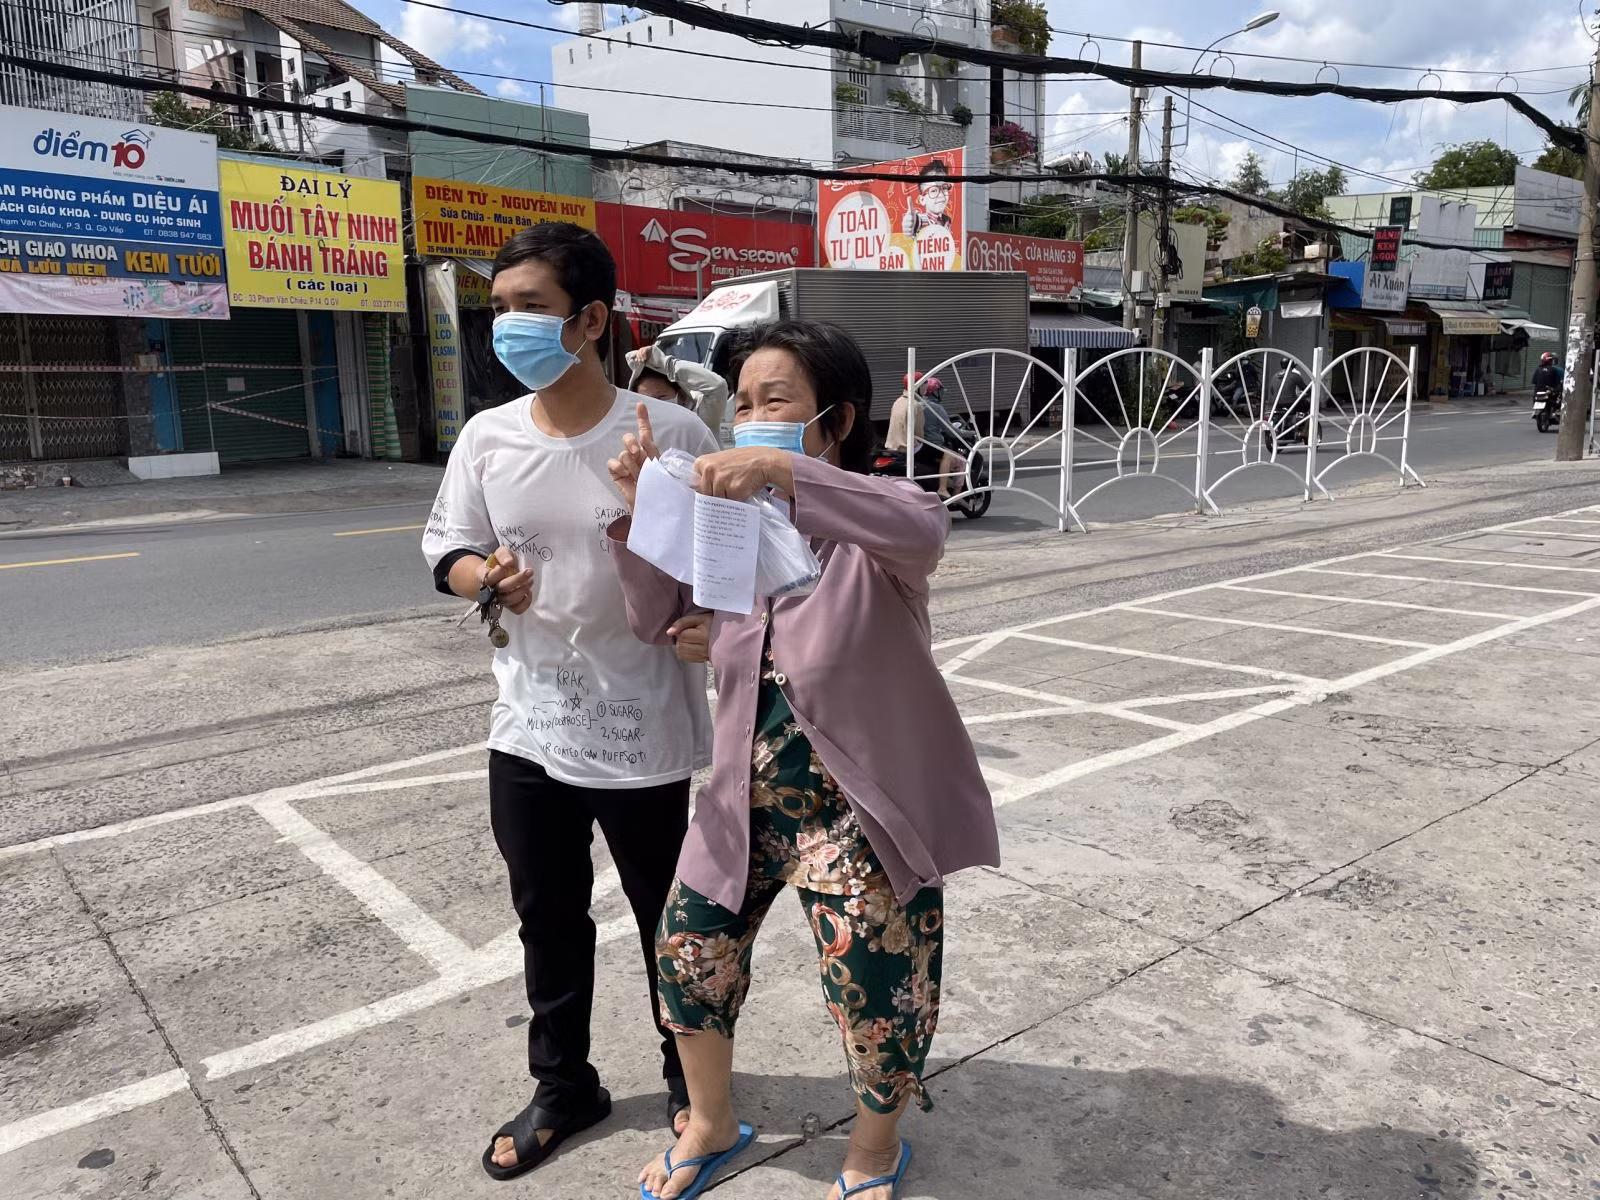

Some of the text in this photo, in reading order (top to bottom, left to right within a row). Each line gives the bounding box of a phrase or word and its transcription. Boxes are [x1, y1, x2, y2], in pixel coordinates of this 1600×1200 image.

[280, 175, 352, 198] ĐẠI LÝ
[21, 185, 76, 201] PHÒNG
[133, 191, 181, 214] DIỆU
[188, 194, 208, 214] ÁI
[425, 185, 463, 204] ĐIỆN
[560, 202, 586, 217] HUY
[28, 203, 56, 215] GIÁO
[60, 207, 91, 218] KHOA
[101, 211, 132, 223] DỤNG
[135, 214, 149, 226] CỤ
[152, 215, 174, 228] HỌC
[176, 218, 201, 228] SINH
[230, 196, 398, 244] MUỐI TÂY NINH
[440, 206, 458, 219] Sửa
[461, 209, 484, 222] Chữa
[494, 213, 513, 225] Mua
[516, 216, 532, 226] Bán
[838, 204, 878, 234] TOÁN
[423, 220, 454, 244] TIVI
[917, 232, 950, 255] TIẾNG
[71, 242, 118, 260] KHOA
[248, 236, 314, 272] BÁNH
[830, 234, 886, 261] TƯ DUY
[1025, 242, 1076, 264] CỬA HÀNG 39
[125, 250, 170, 274] KEM
[711, 264, 734, 278] Trung
[879, 249, 904, 270] BÁN
[922, 256, 945, 270] ANH
[436, 329, 452, 340] LCD
[432, 346, 456, 356] PLASMA
[438, 361, 454, 372] LED
[440, 426, 456, 436] LOA
